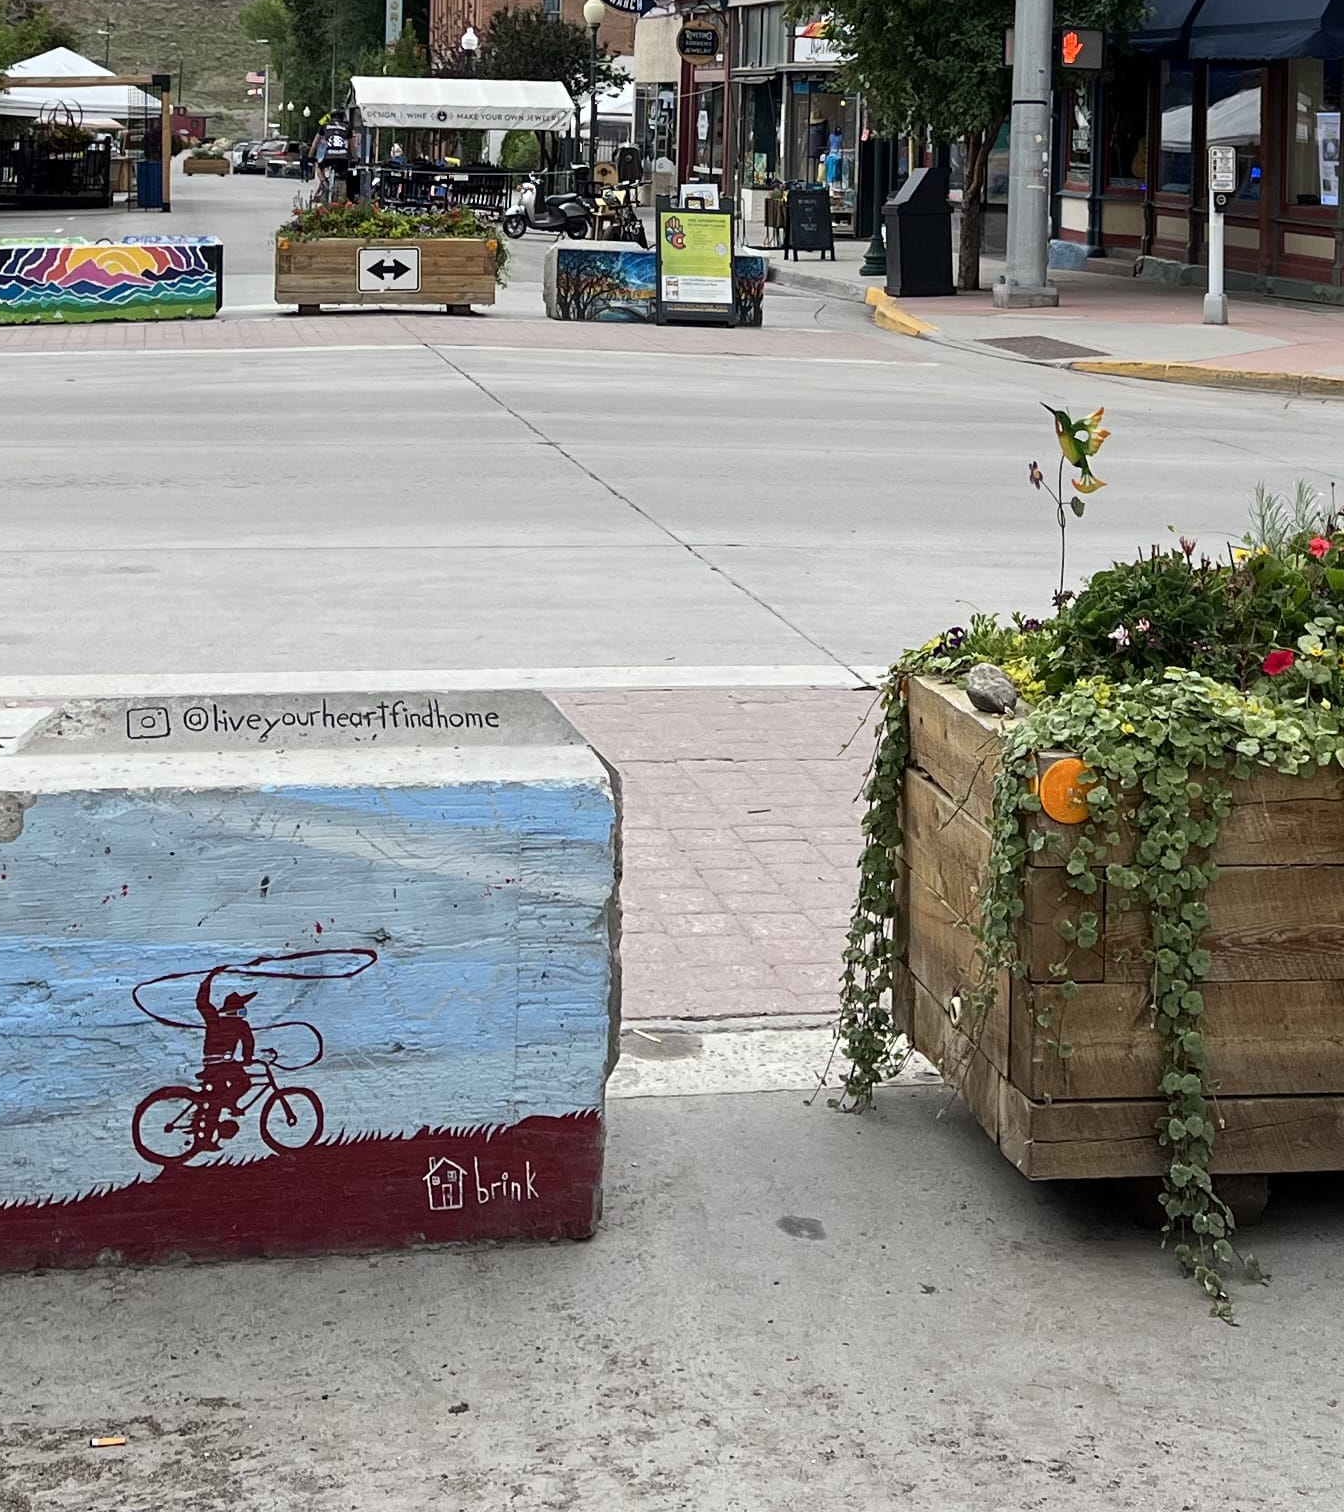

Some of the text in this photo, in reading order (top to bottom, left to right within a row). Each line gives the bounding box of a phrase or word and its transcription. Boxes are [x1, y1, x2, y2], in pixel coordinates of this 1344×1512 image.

[481, 113, 502, 121] YOUR
[183, 699, 500, 744] @liveyourheartfindhome
[474, 1156, 540, 1204] brink
